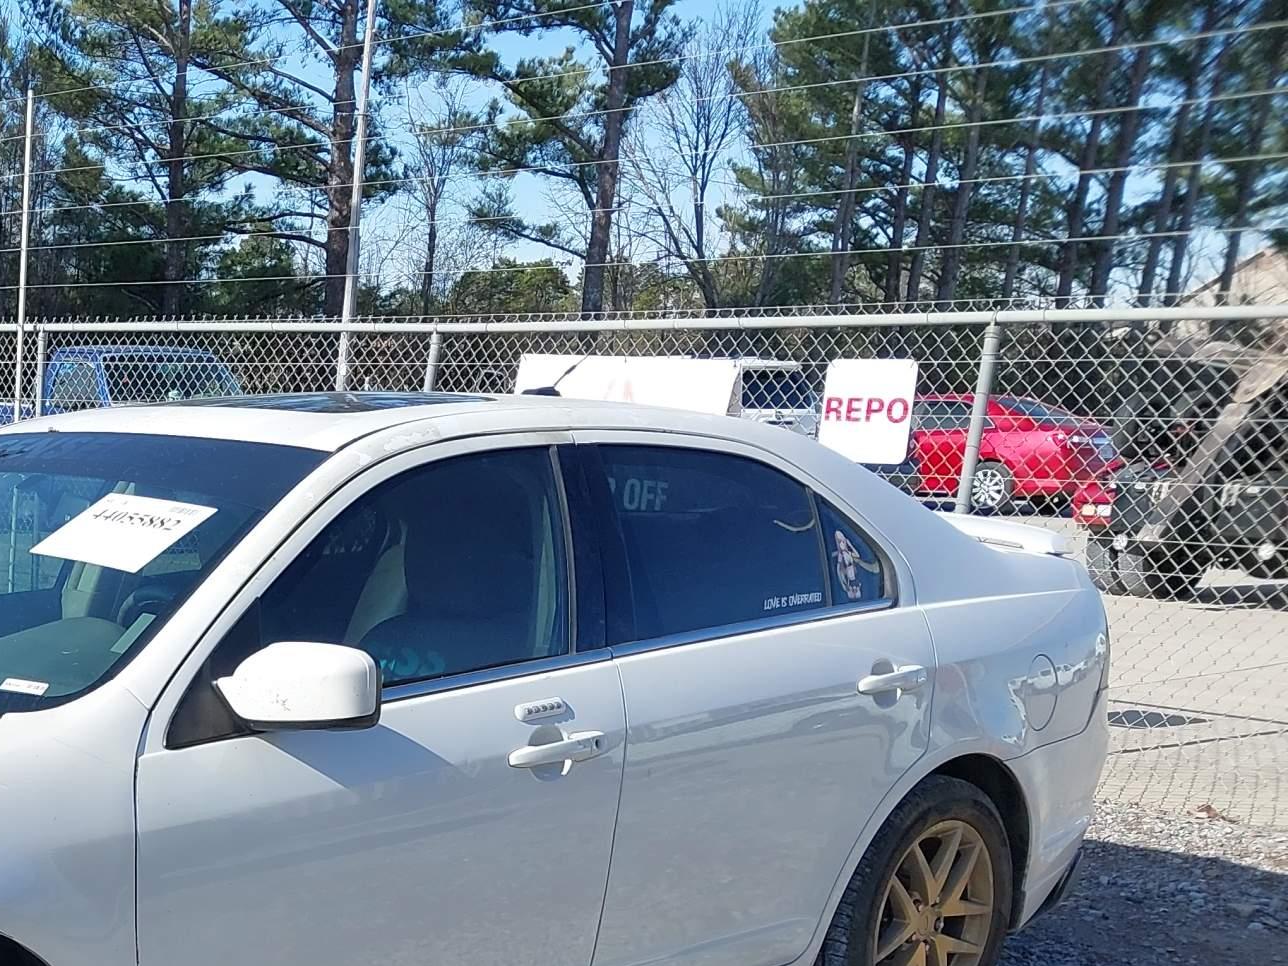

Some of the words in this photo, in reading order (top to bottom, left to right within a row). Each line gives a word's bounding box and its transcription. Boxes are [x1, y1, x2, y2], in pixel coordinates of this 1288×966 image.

[824, 396, 910, 424] REPO
[623, 478, 669, 511] OFF
[93, 509, 182, 531] 44055882
[763, 596, 781, 610] LOVE
[781, 597, 789, 607] IS
[789, 592, 823, 607] OVERRATED
